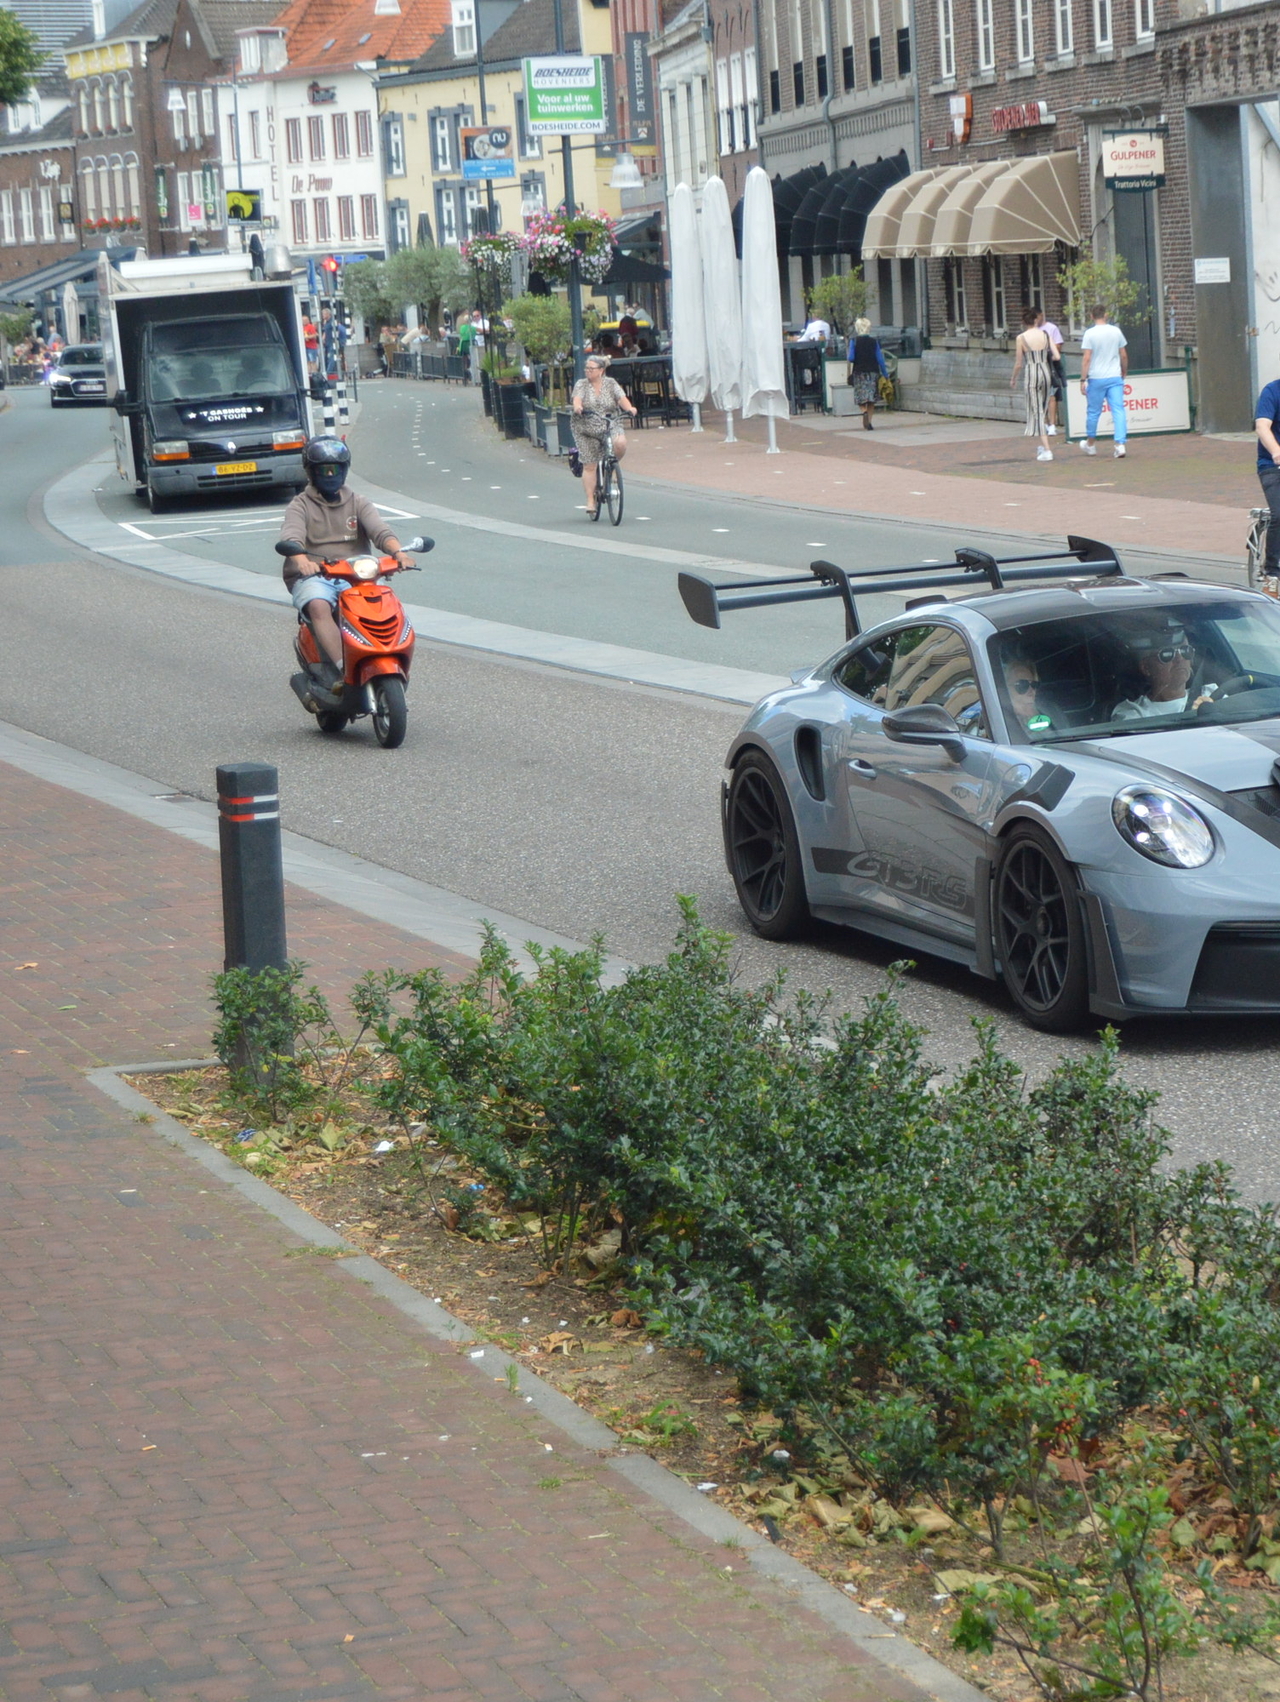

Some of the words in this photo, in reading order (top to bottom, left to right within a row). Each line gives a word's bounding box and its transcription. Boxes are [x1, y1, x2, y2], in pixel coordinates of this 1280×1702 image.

[534, 67, 593, 77] BOESHEIDE
[534, 77, 590, 86] HOVENIERS
[537, 94, 560, 103] Voor
[563, 93, 572, 102] al
[574, 94, 590, 102] uw
[537, 103, 593, 113] tuinwerken
[636, 98, 645, 112] DE
[532, 121, 600, 131] BOESHEIDE.COM
[266, 105, 279, 201] HOTEL
[1110, 150, 1156, 161] GULPENER
[292, 175, 303, 193] De
[1114, 180, 1139, 189] Trattoria
[1140, 179, 1157, 187] Vicini
